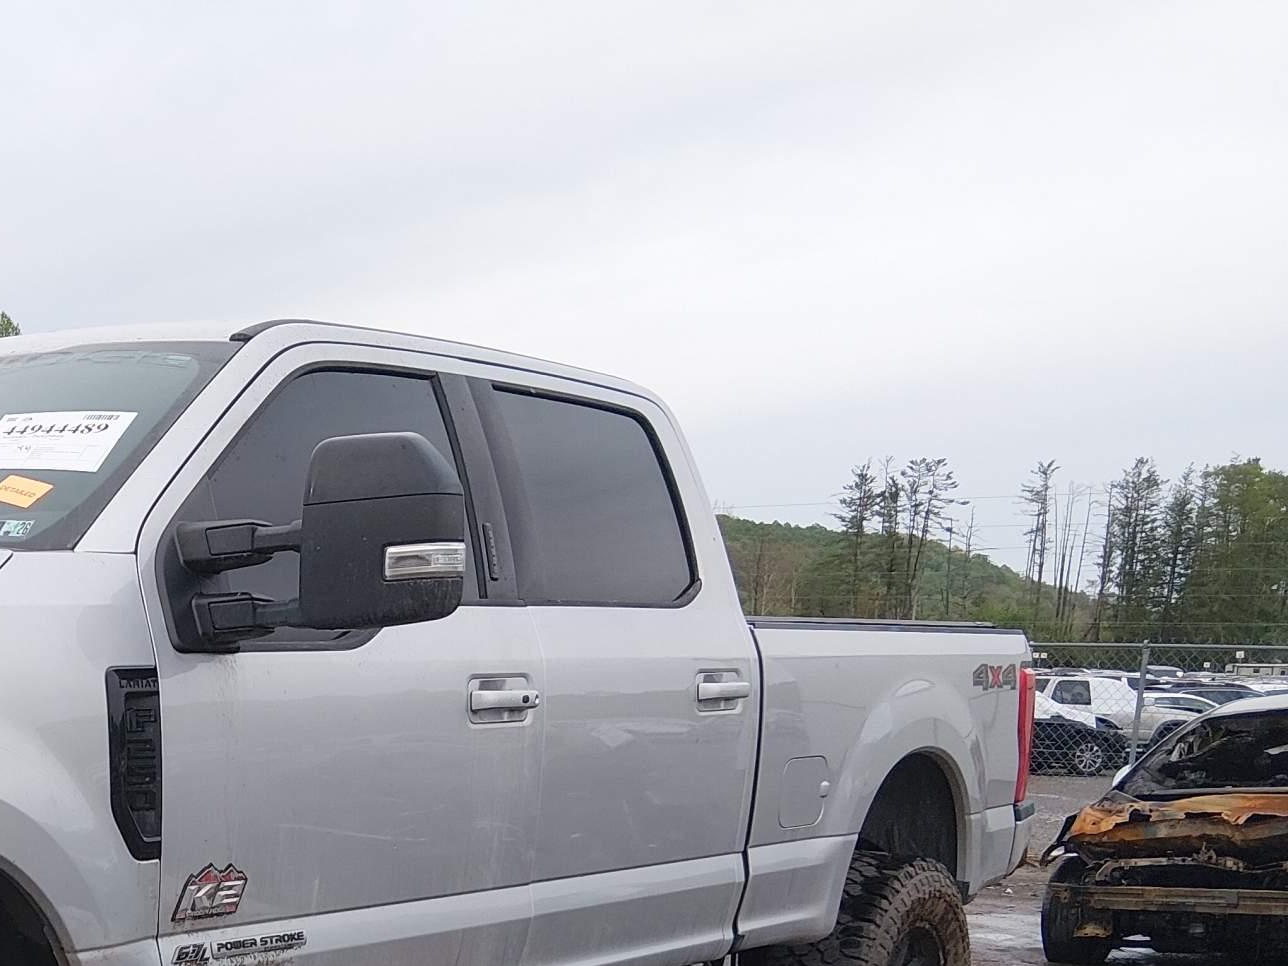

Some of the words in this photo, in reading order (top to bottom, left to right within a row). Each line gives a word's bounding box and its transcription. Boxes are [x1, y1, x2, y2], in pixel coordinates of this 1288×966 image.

[2, 422, 110, 435] 44944489
[119, 679, 158, 688] LARIAT
[176, 943, 211, 963] 6.7L
[216, 938, 258, 953] POWER
[259, 931, 305, 946] STROKE
